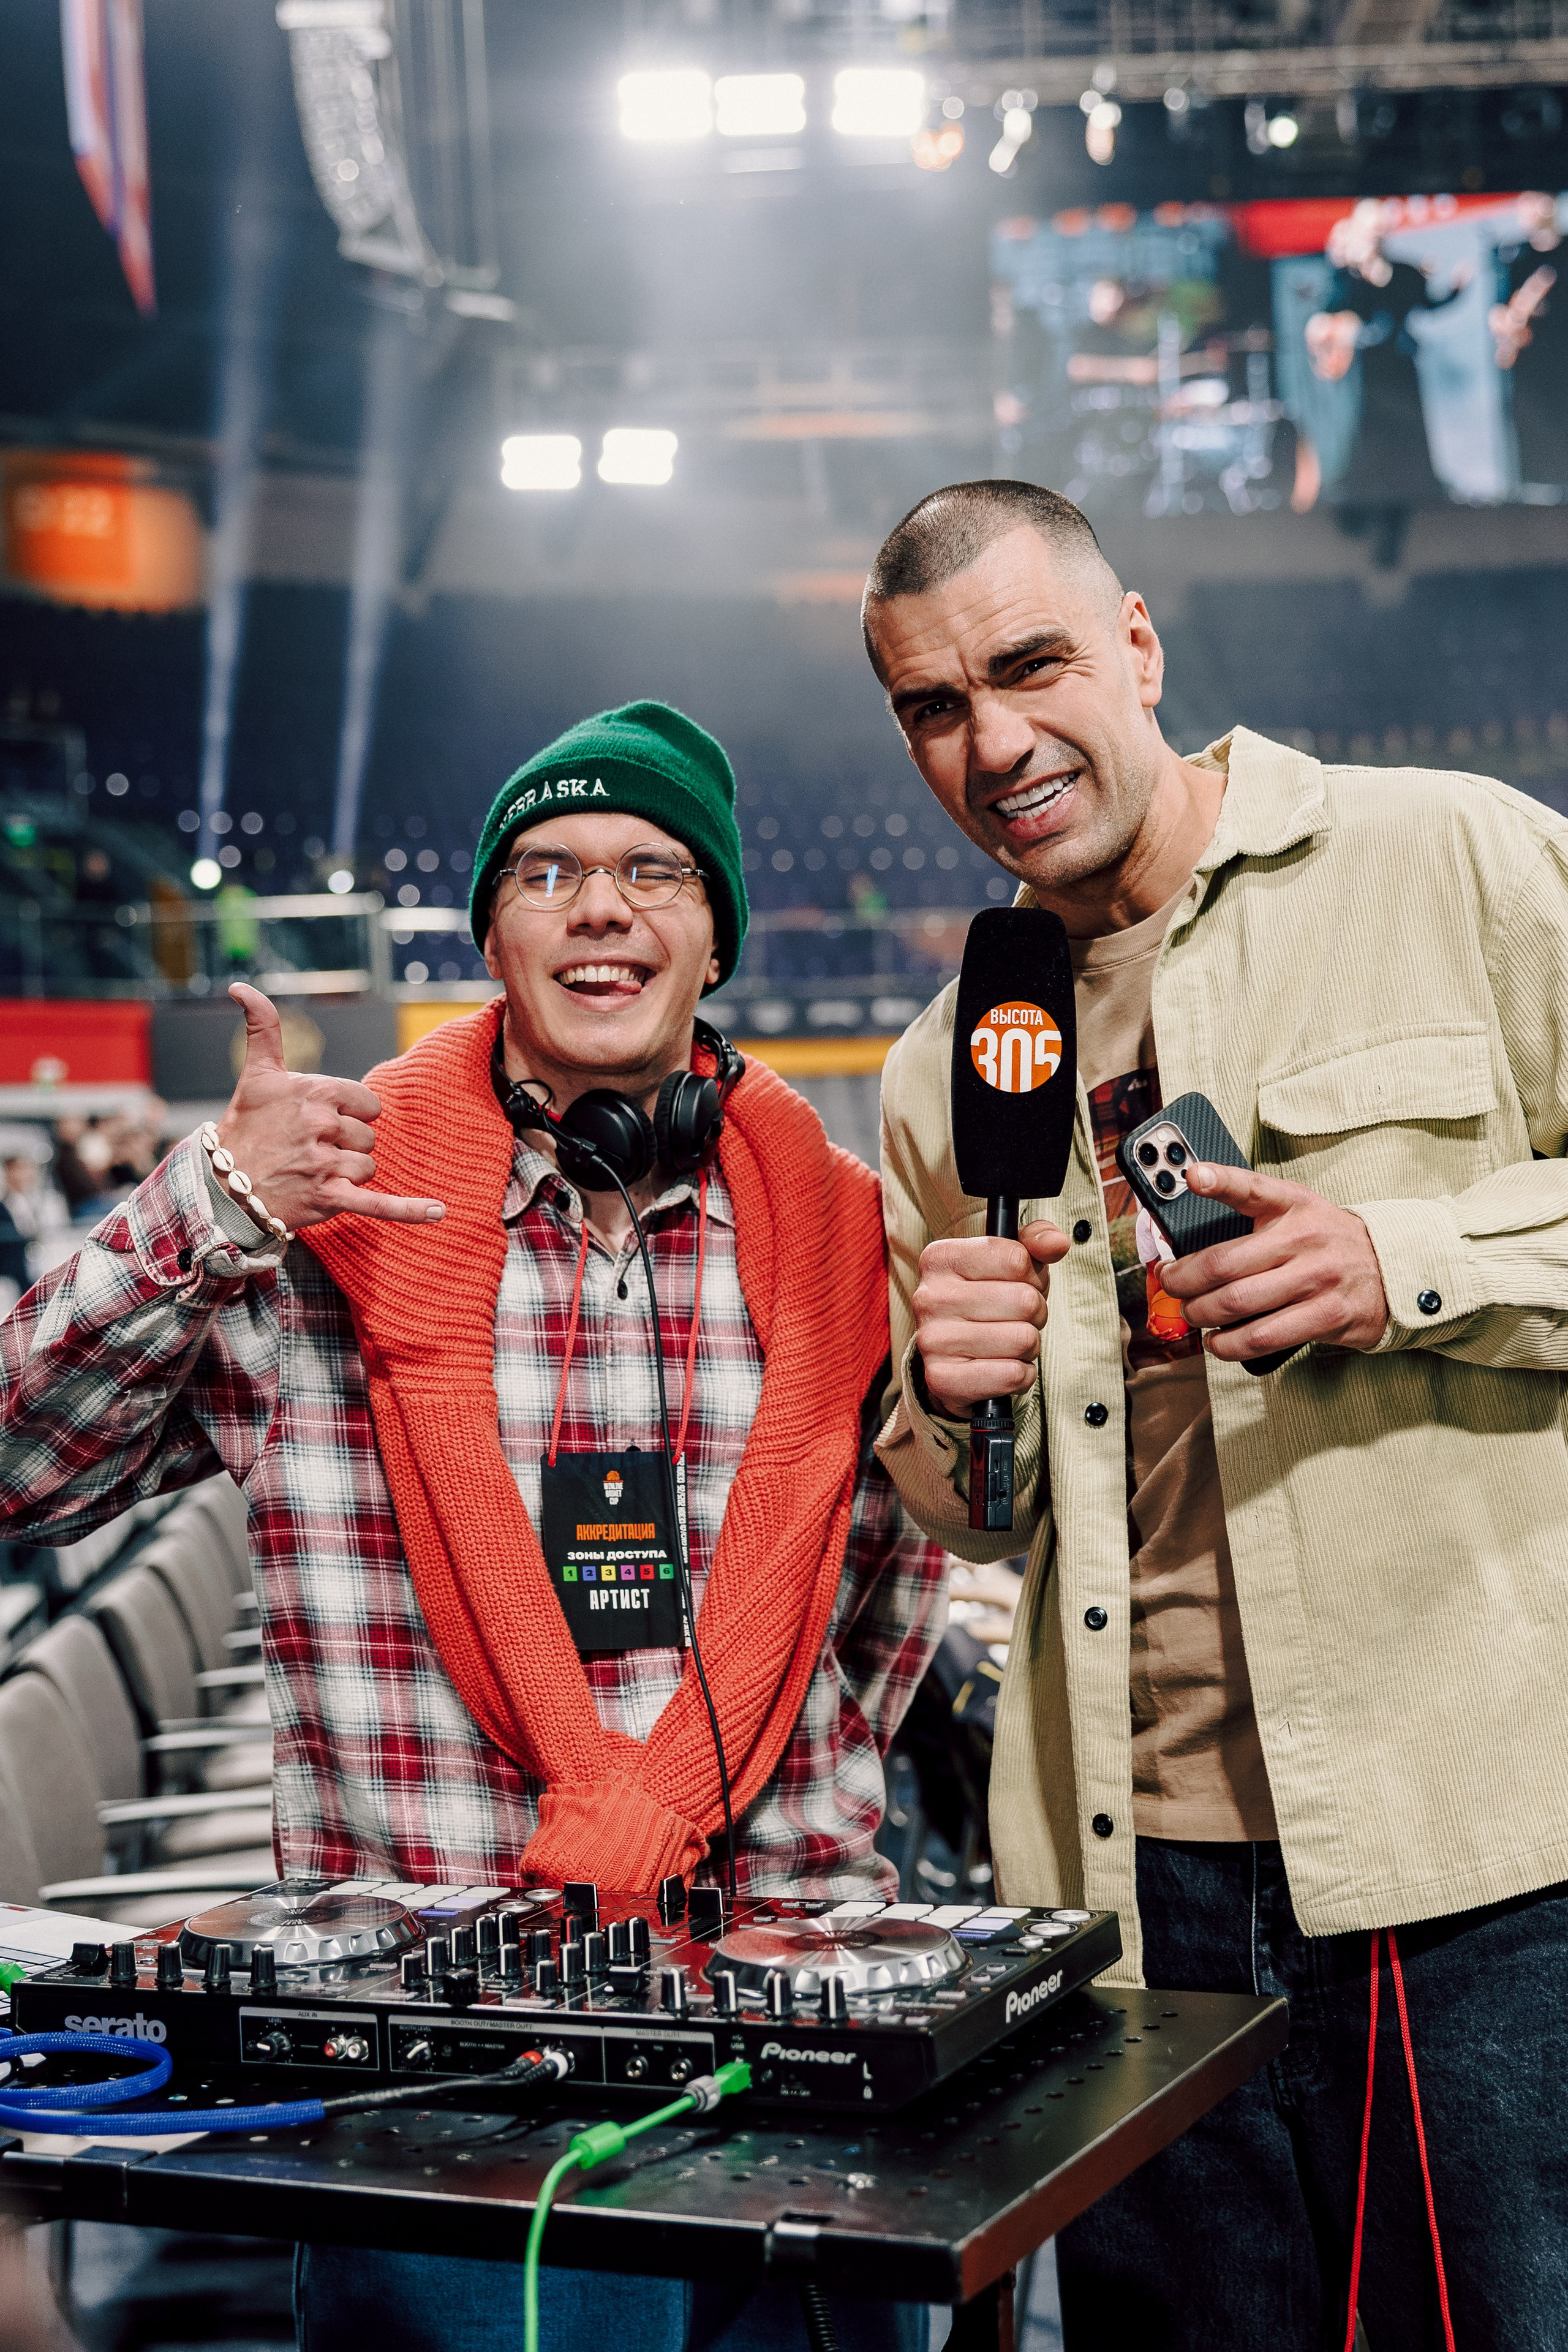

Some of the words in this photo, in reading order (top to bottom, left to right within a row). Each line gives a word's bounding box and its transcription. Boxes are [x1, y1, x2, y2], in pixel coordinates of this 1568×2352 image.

[990, 1009, 1044, 1026] ВЫСОТА
[971, 1028, 1062, 1093] 305
[576, 1523, 655, 1541] АККРЕДИТАЦИЯ
[567, 1551, 605, 1560] ЗОНЫ
[606, 1550, 668, 1561] ДОСТУПА
[589, 1588, 650, 1610] АРТИСТ
[1006, 1969, 1063, 2024] Pioneer
[64, 2013, 167, 2043] serato
[760, 2041, 857, 2064] Pioneer
